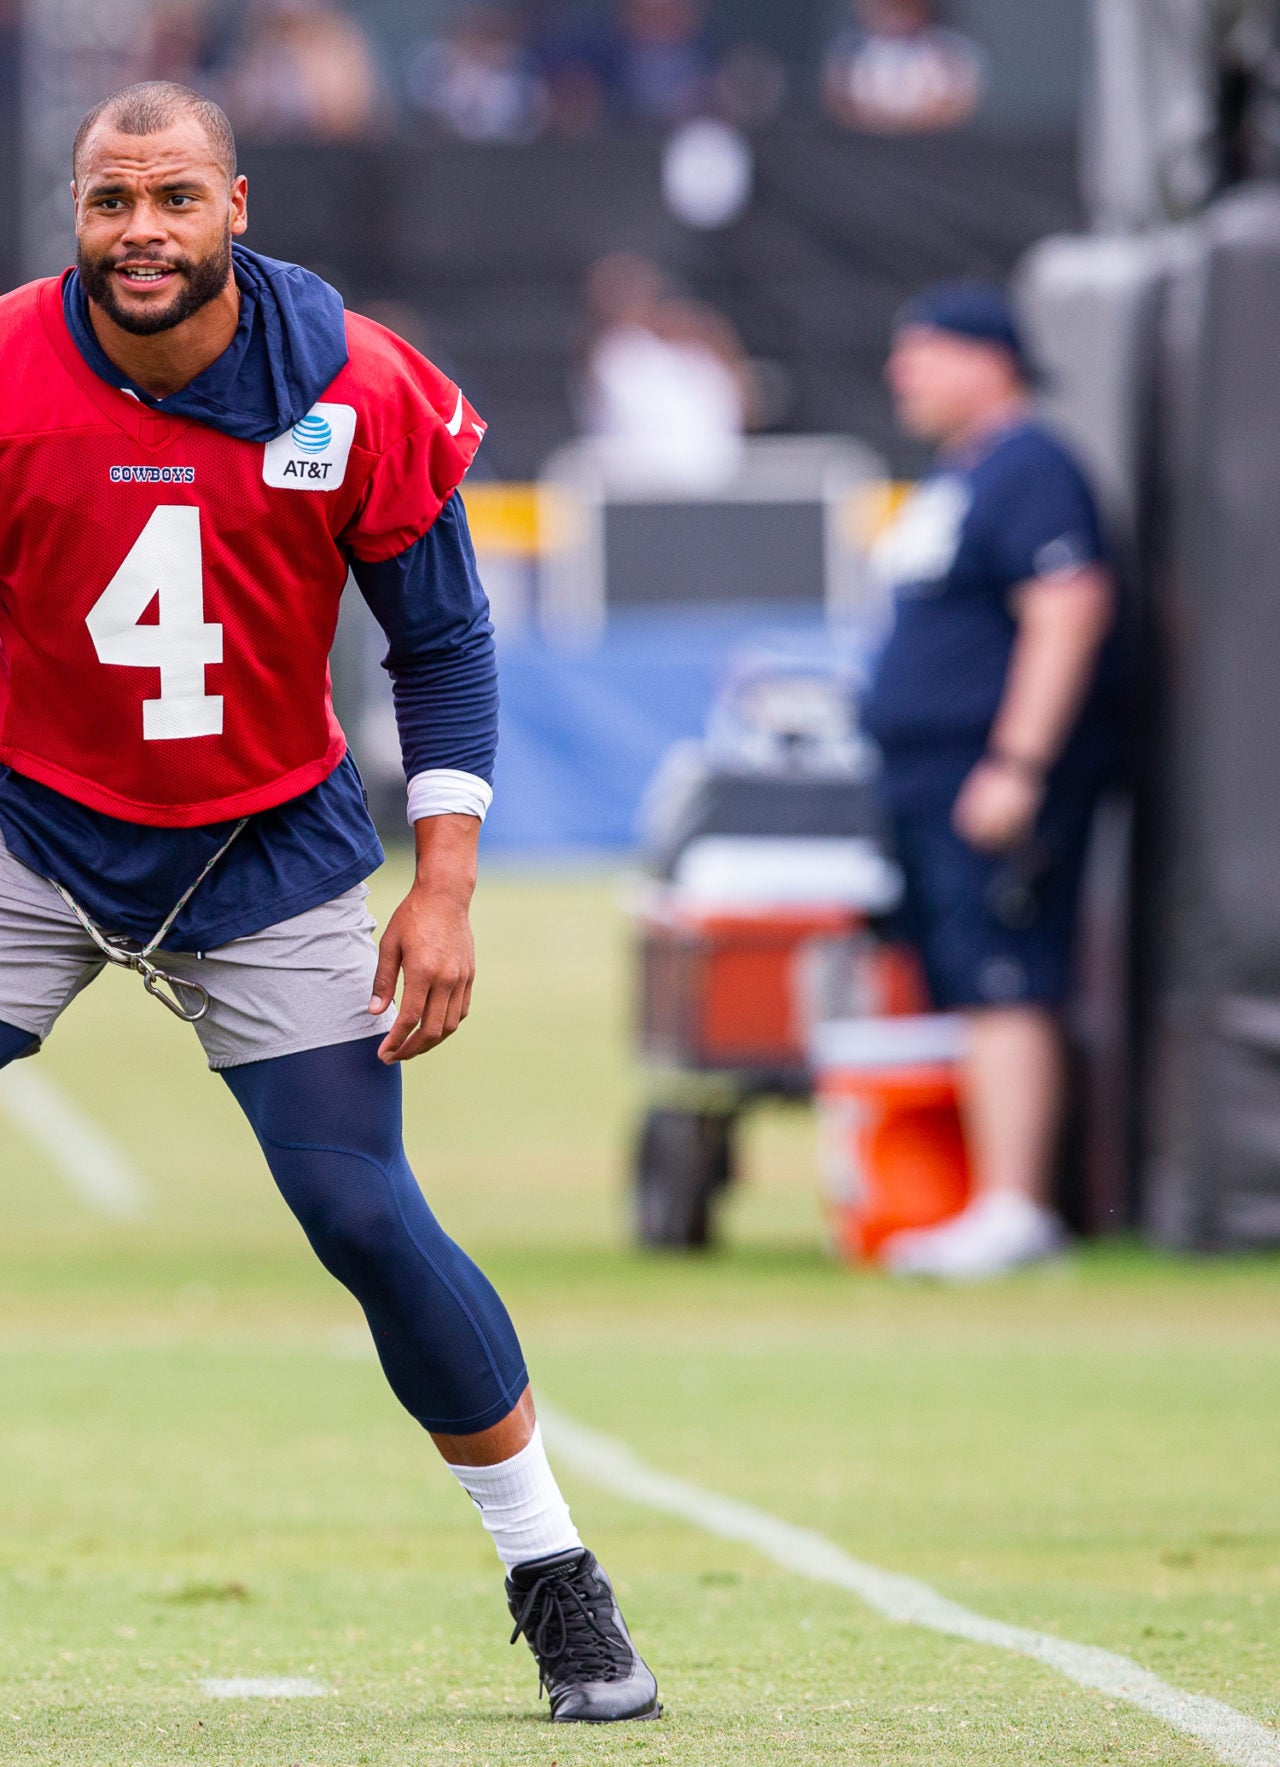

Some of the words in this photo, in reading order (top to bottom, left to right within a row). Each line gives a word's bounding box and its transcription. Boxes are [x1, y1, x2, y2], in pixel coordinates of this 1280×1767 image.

[110, 466, 195, 483] COWBOYS
[283, 460, 332, 479] AT&T
[85, 505, 223, 740] 4
